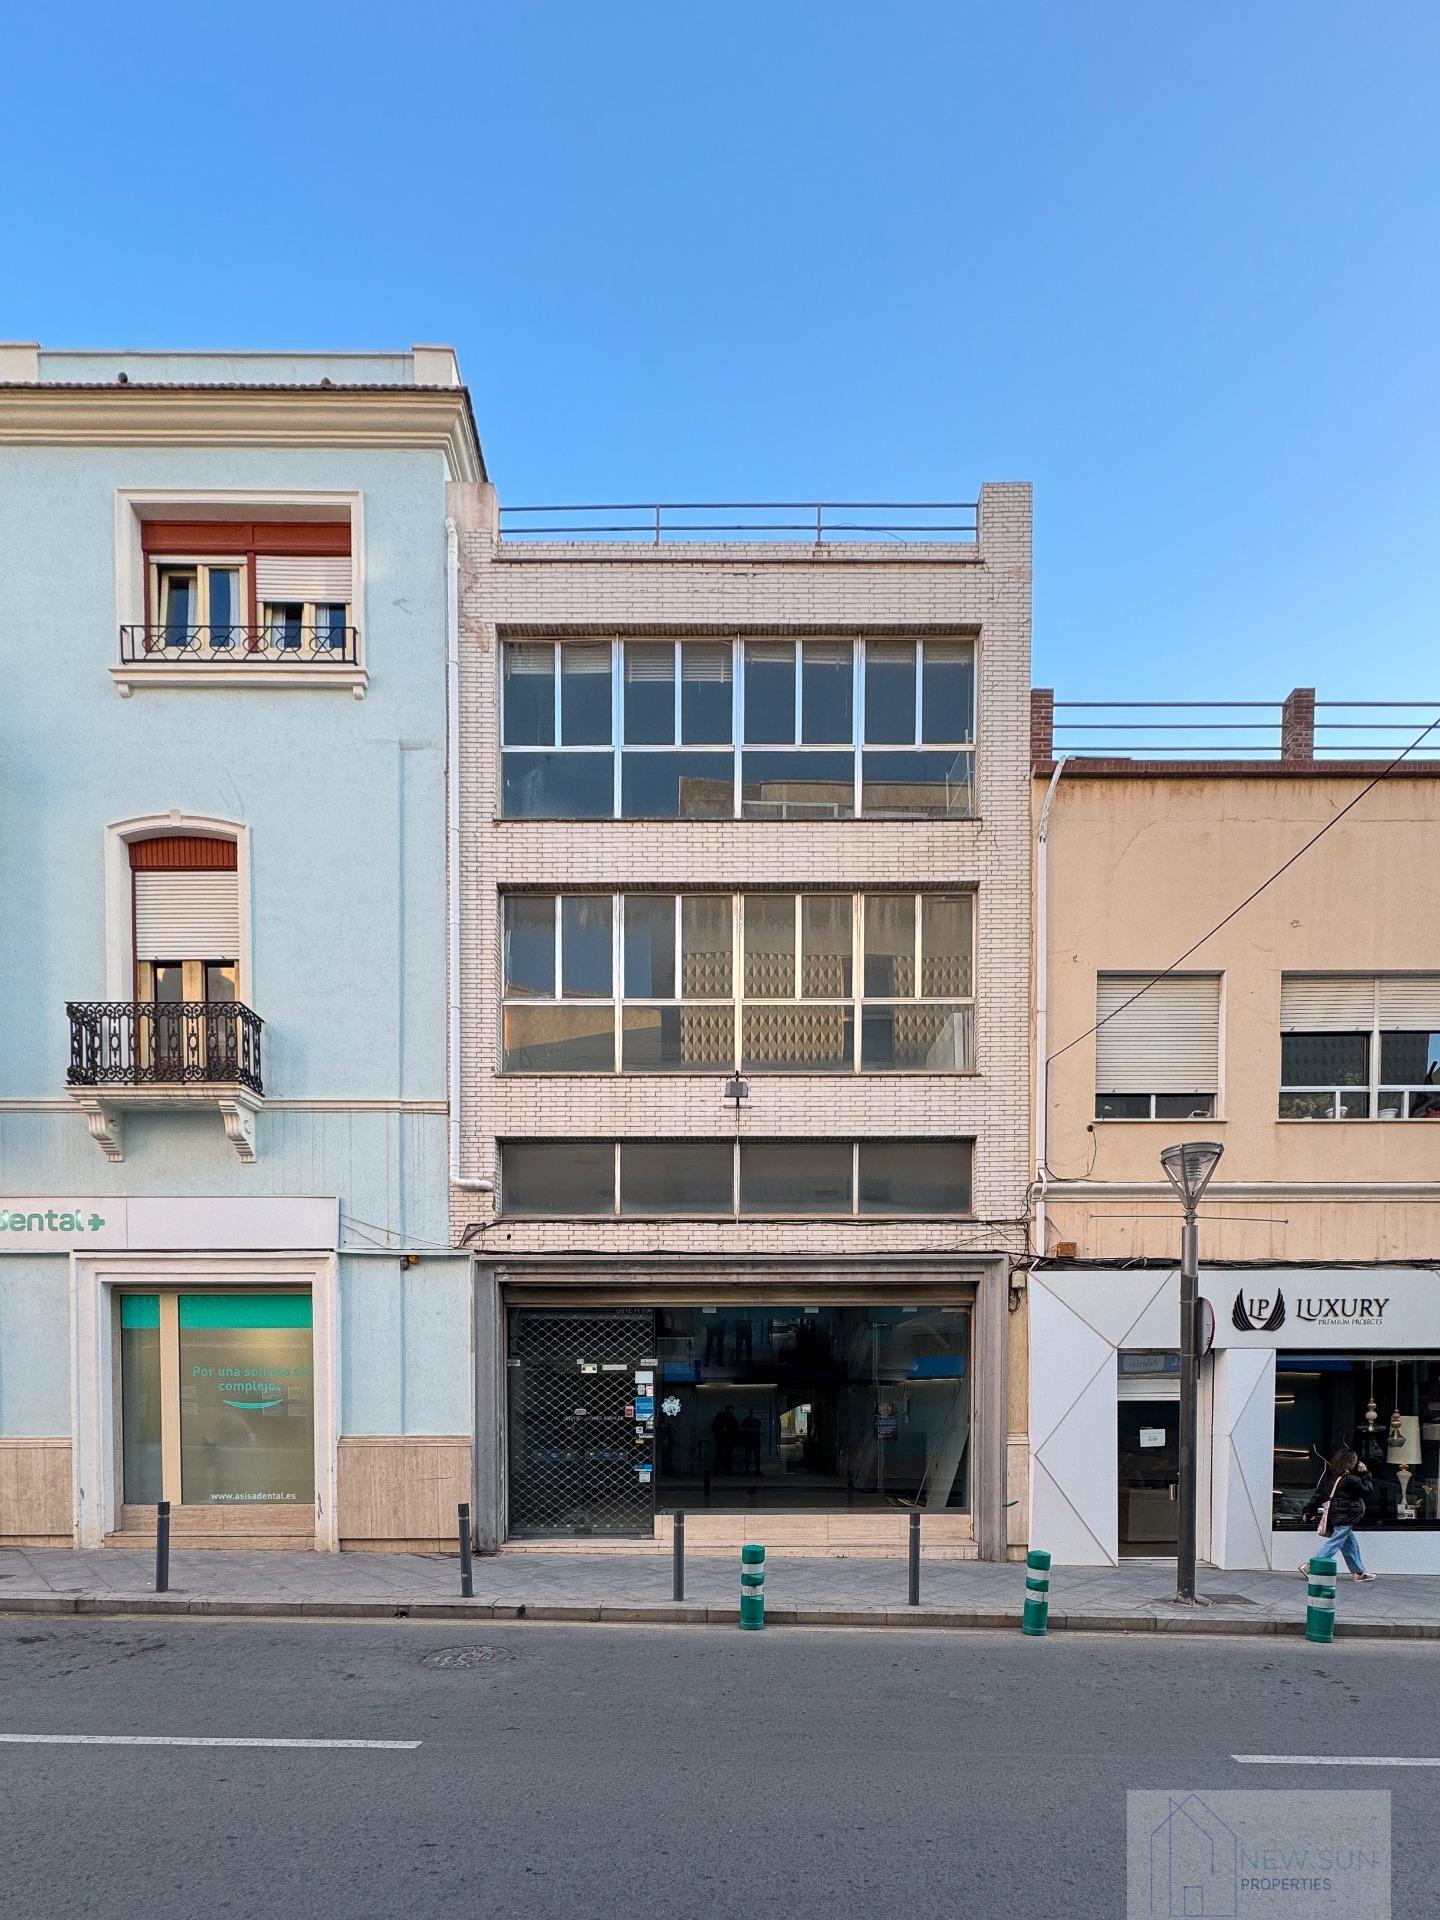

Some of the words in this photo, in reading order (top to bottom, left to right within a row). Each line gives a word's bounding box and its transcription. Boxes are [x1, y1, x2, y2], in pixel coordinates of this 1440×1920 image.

[1248, 1298, 1269, 1320] LP
[1295, 1298, 1390, 1321] LUXURY
[192, 1366, 215, 1378] Por
[218, 1368, 241, 1378] una
[218, 1380, 282, 1394] complejos
[211, 1492, 296, 1500] www.asisadental.es
